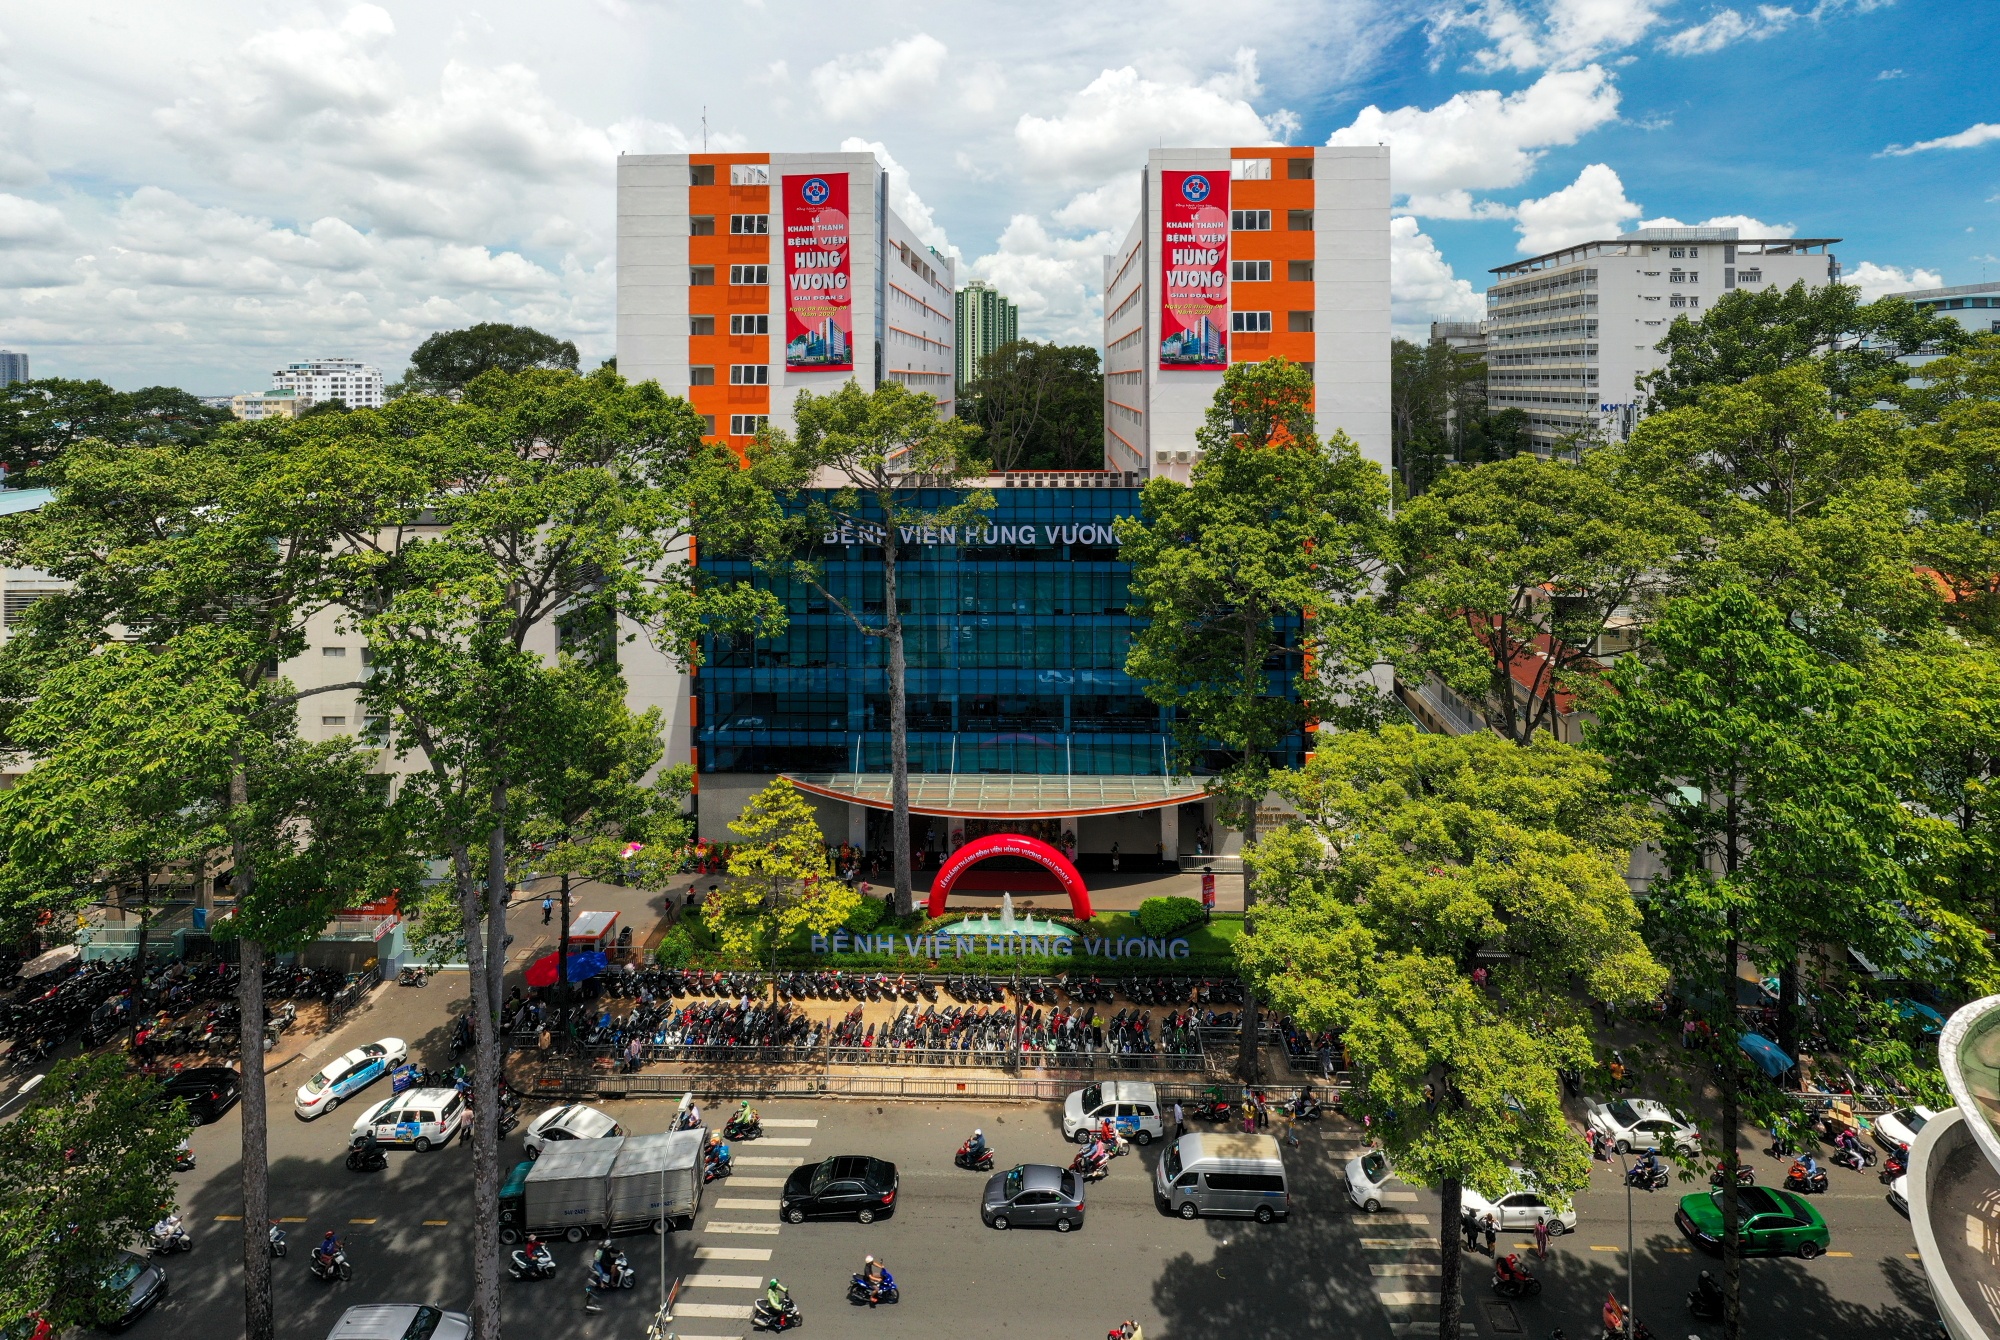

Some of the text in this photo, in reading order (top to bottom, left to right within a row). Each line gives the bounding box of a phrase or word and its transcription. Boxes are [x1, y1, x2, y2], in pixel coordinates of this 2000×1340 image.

[788, 235, 847, 247] BỆNH VIỆN
[1166, 232, 1225, 244] BỆNH VIỆN
[795, 248, 841, 269] HÙNG
[1172, 245, 1219, 265] HÙNG
[790, 272, 847, 290] VƯƠNG
[1166, 270, 1224, 288] VƯƠNG
[965, 520, 1036, 545] HÙNG
[1044, 522, 1124, 545] VƯƠN
[1003, 845, 1020, 853] HÙNG
[986, 930, 1073, 957] HÙNG
[1083, 934, 1190, 960] VƯƠNG
